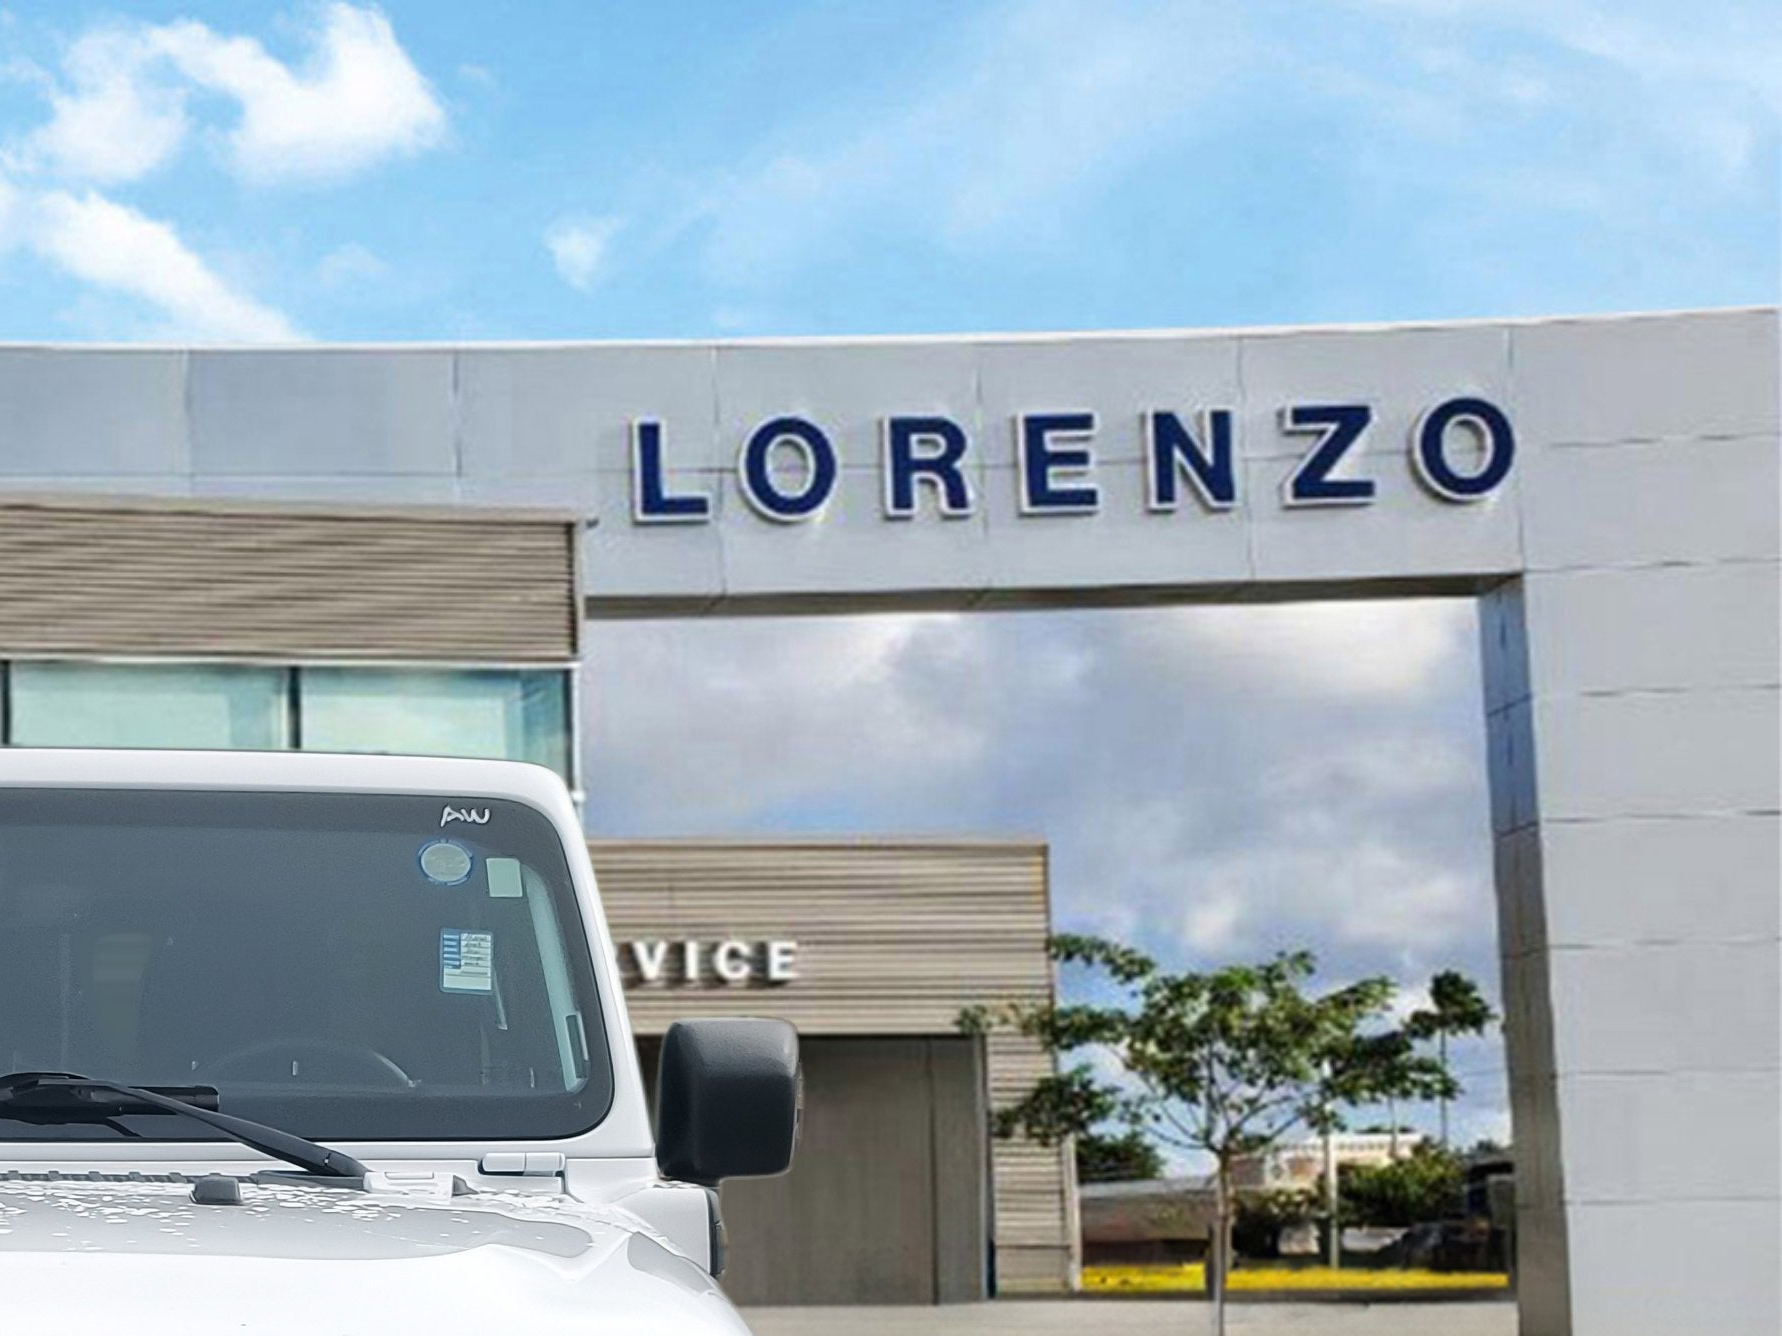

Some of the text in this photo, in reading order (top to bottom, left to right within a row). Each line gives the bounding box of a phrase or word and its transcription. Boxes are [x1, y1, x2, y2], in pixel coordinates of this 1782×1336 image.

[630, 396, 1517, 521] LORENZO
[440, 805, 491, 828] AW
[631, 940, 801, 980] VICE
